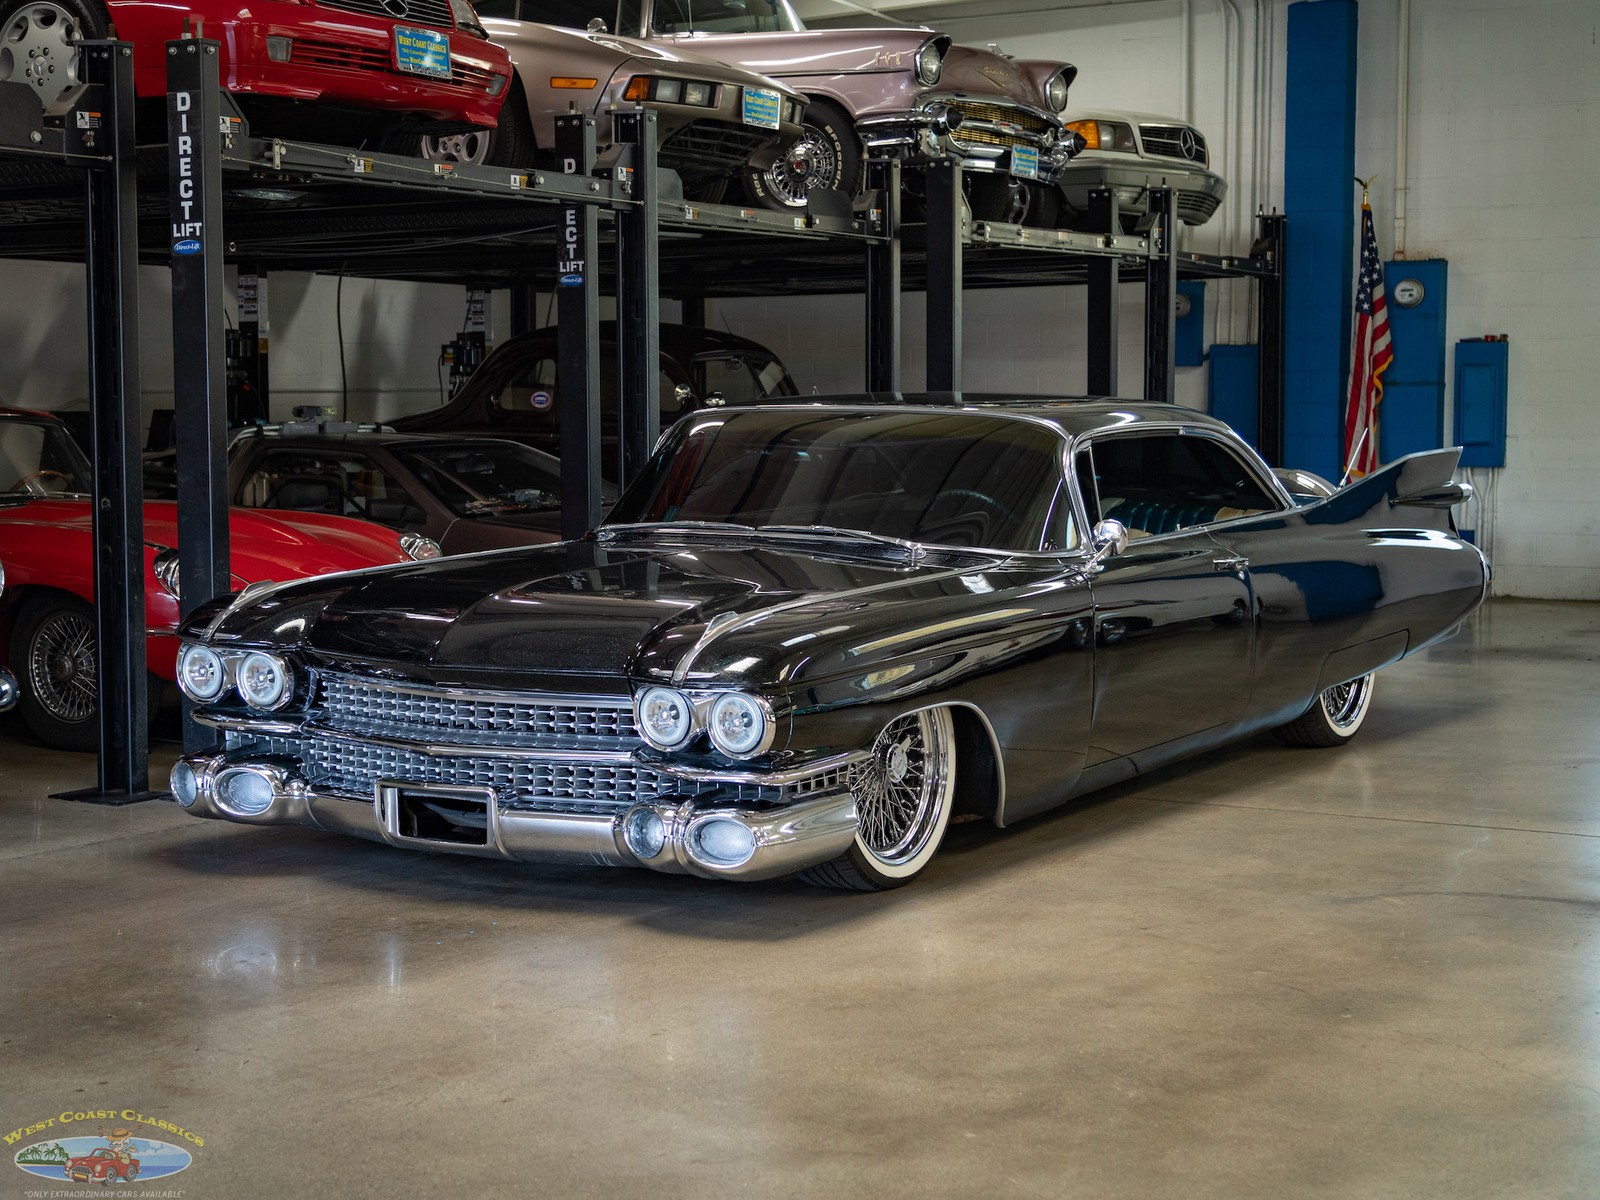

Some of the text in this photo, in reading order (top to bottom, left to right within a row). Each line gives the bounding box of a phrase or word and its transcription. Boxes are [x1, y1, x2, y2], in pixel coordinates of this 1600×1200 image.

[176, 92, 193, 220] DIRECT
[173, 223, 202, 238] LIFT
[563, 158, 577, 259] DECT
[559, 261, 585, 272] LIFT
